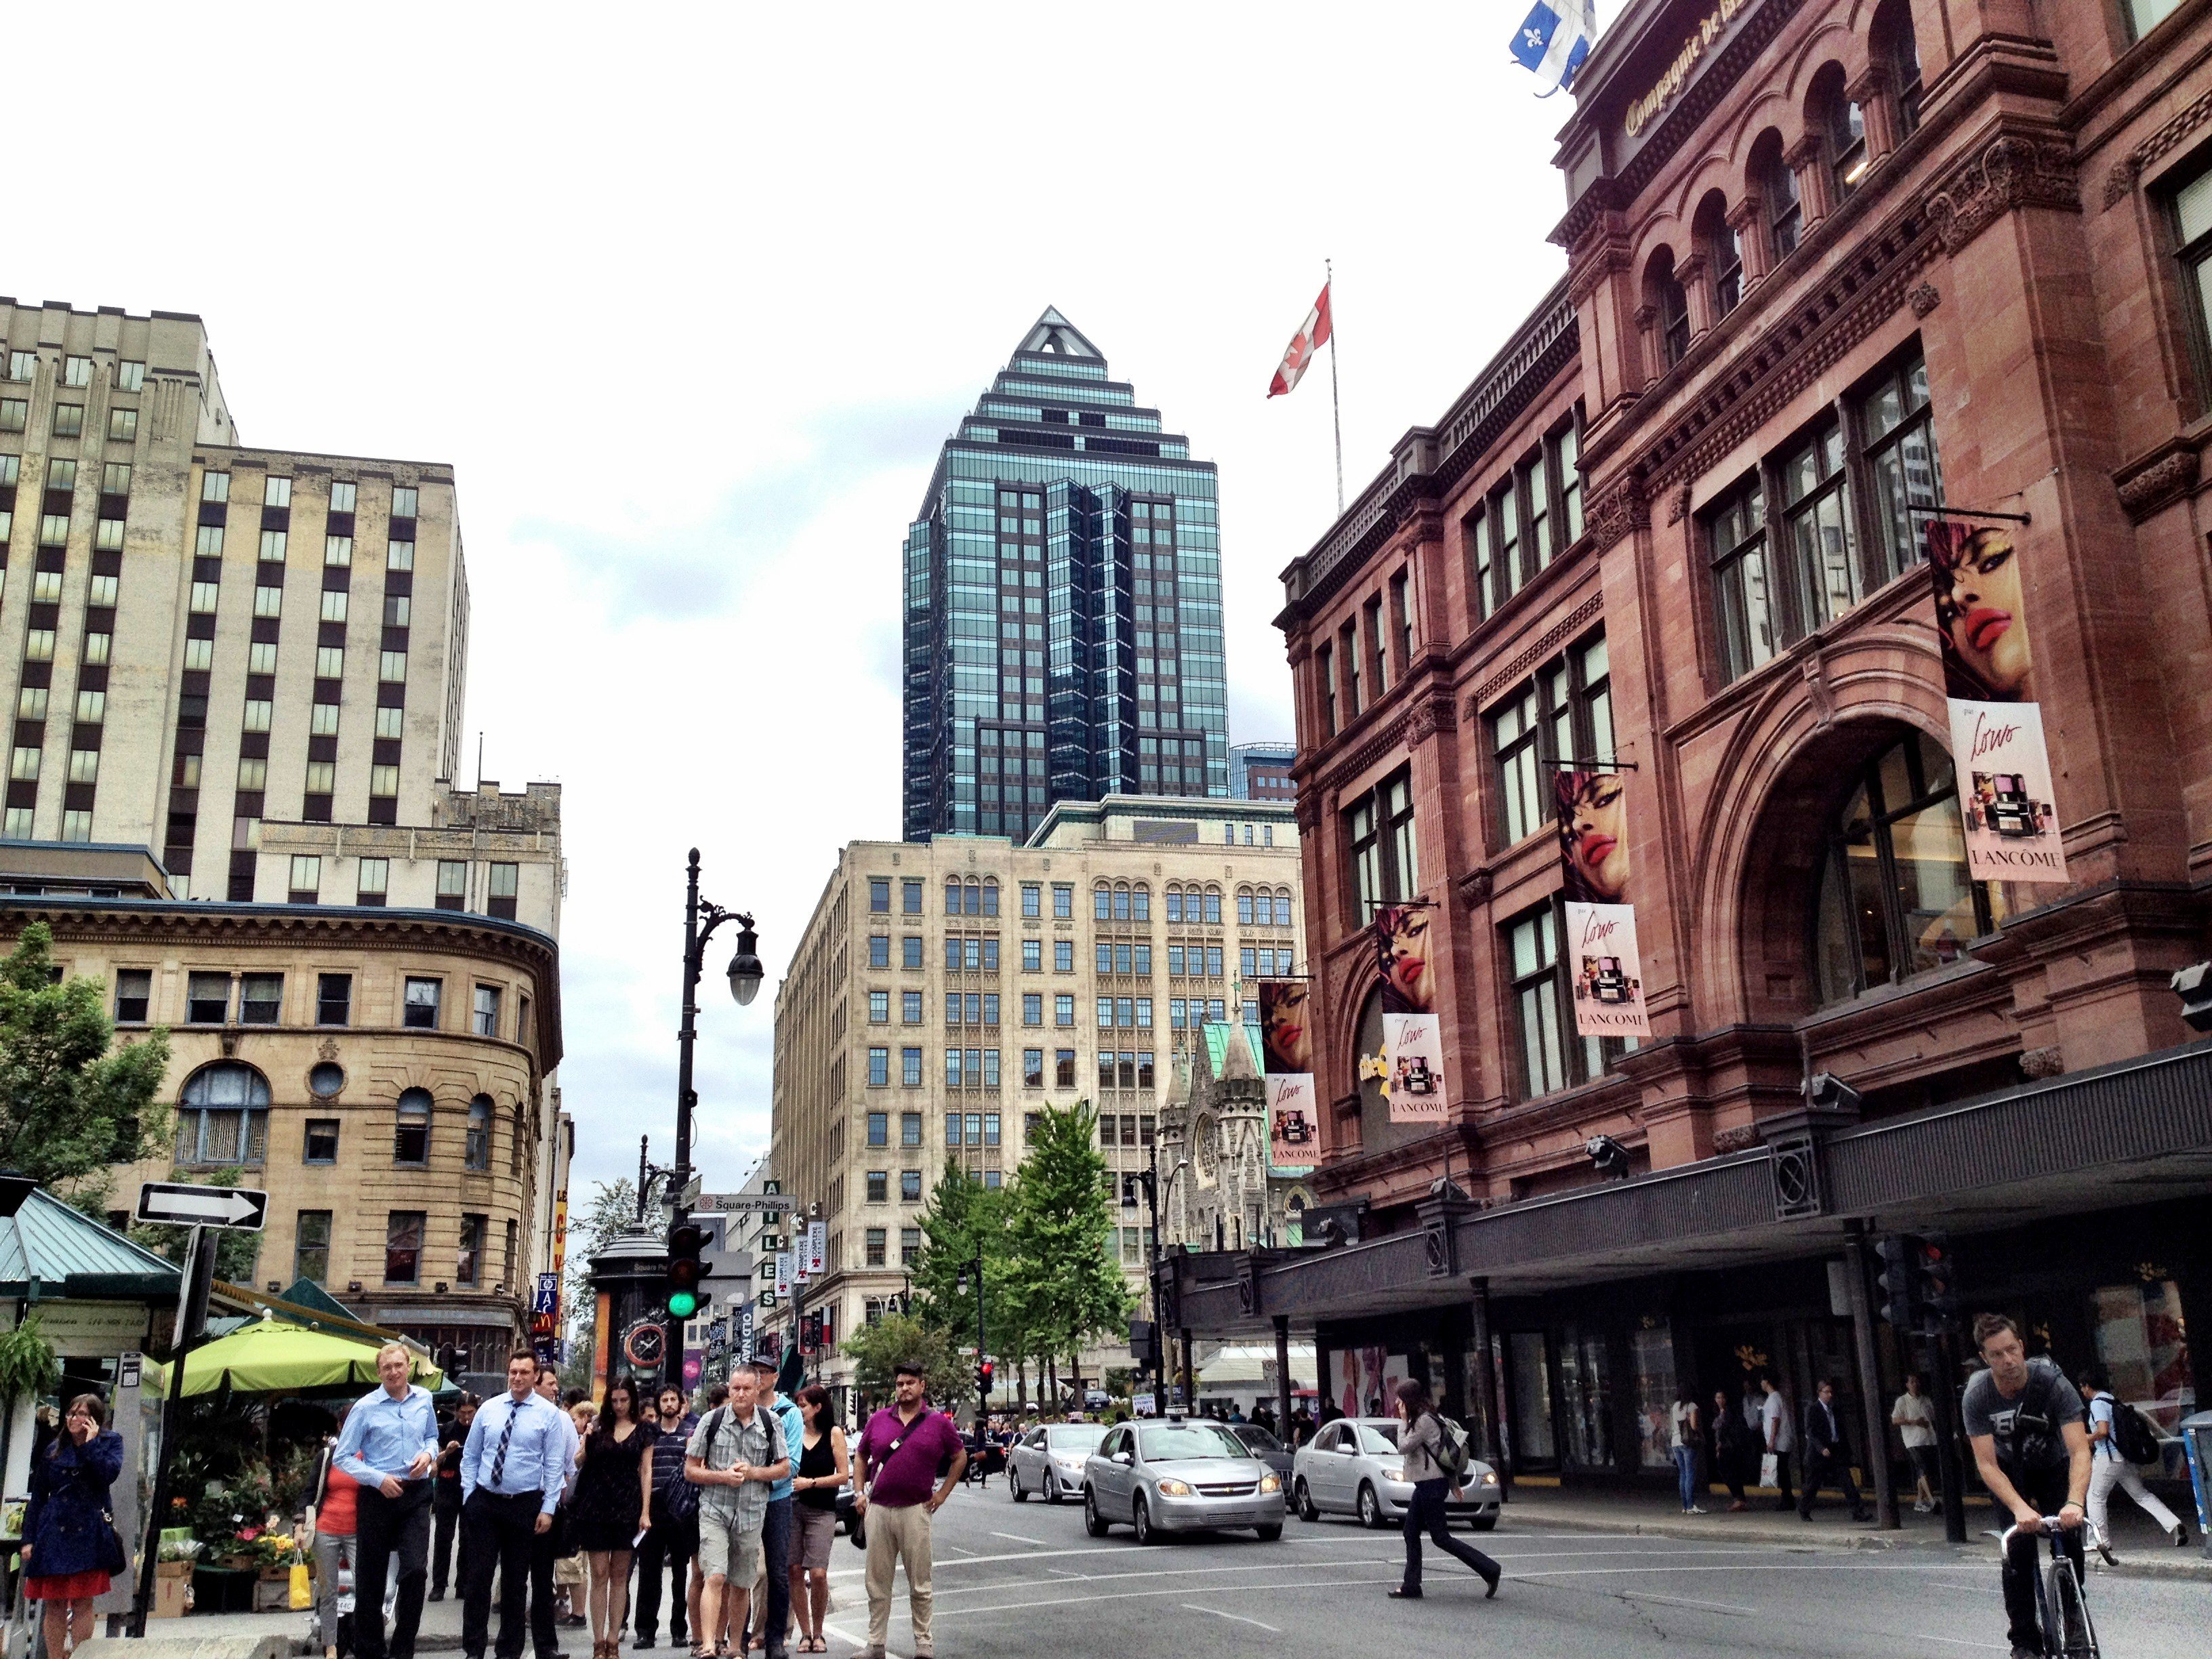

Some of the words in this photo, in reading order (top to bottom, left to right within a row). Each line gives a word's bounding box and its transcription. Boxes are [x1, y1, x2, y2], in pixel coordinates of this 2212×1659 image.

[1625, 35, 1700, 137] Compagnie
[1699, 11, 1719, 45] de
[1971, 848, 2061, 868] LANCÔME
[1579, 1012, 1643, 1025] LANCÔME
[557, 1190, 567, 1202] LE
[716, 1200, 790, 1211] Square-Phillips
[634, 1263, 657, 1271] Square
[743, 1313, 752, 1336] OLD
